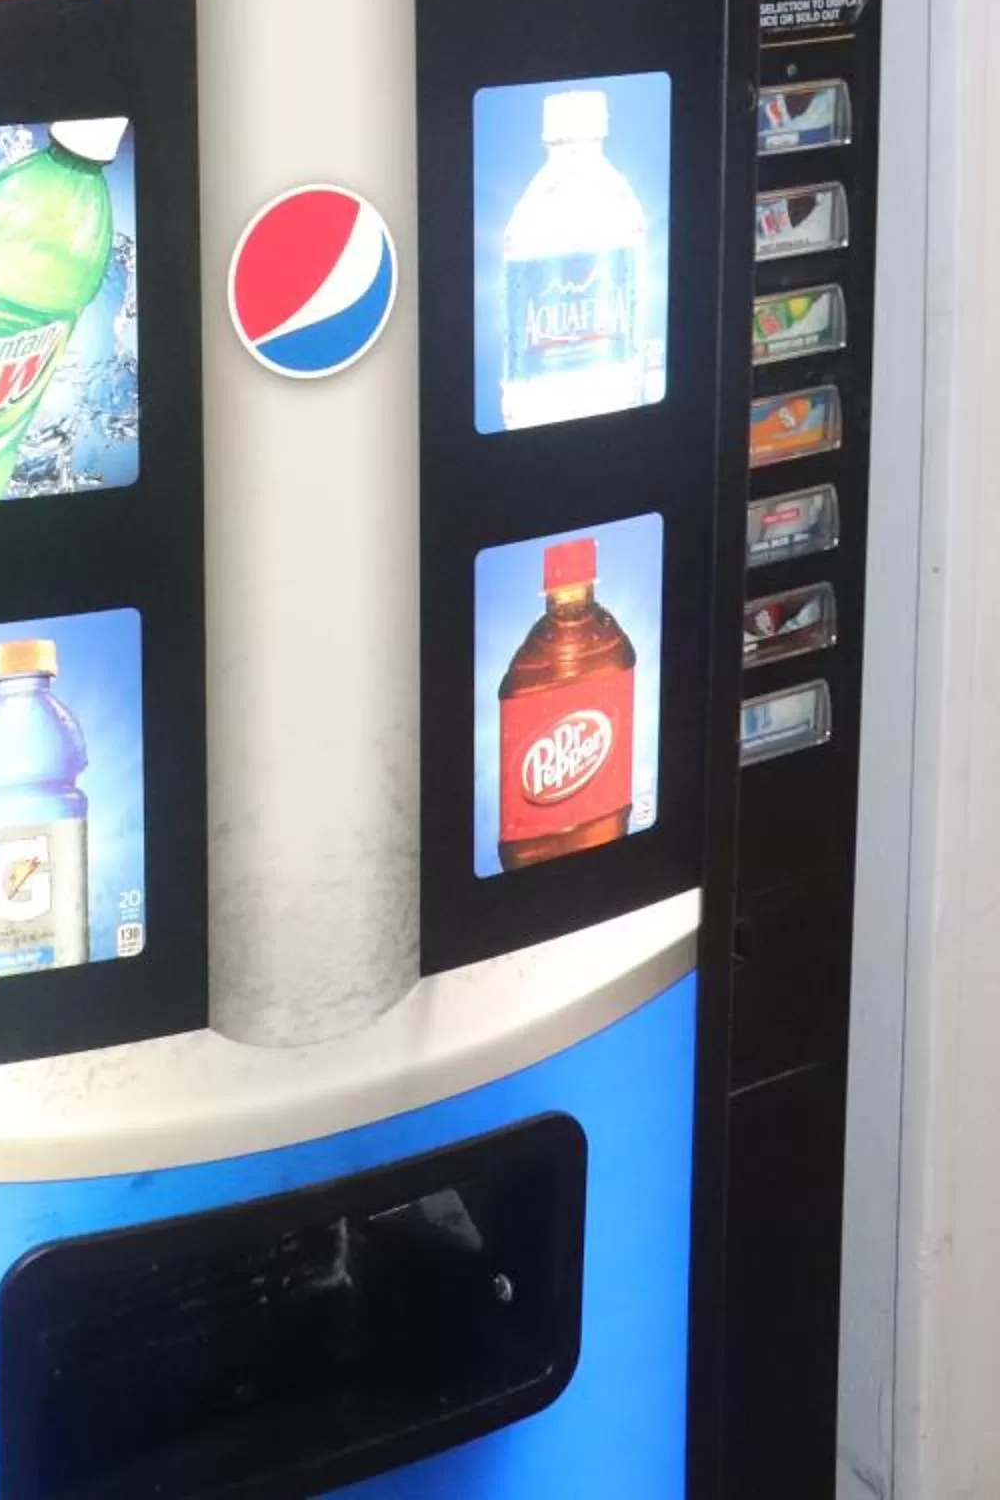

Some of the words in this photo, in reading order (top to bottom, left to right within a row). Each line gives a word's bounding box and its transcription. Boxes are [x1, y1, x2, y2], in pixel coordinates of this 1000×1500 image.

[760, 0, 811, 15] SELECTION
[780, 13, 794, 25] OR
[796, 11, 820, 23] SOLD
[822, 9, 841, 21] OUT
[119, 889, 141, 909] 20
